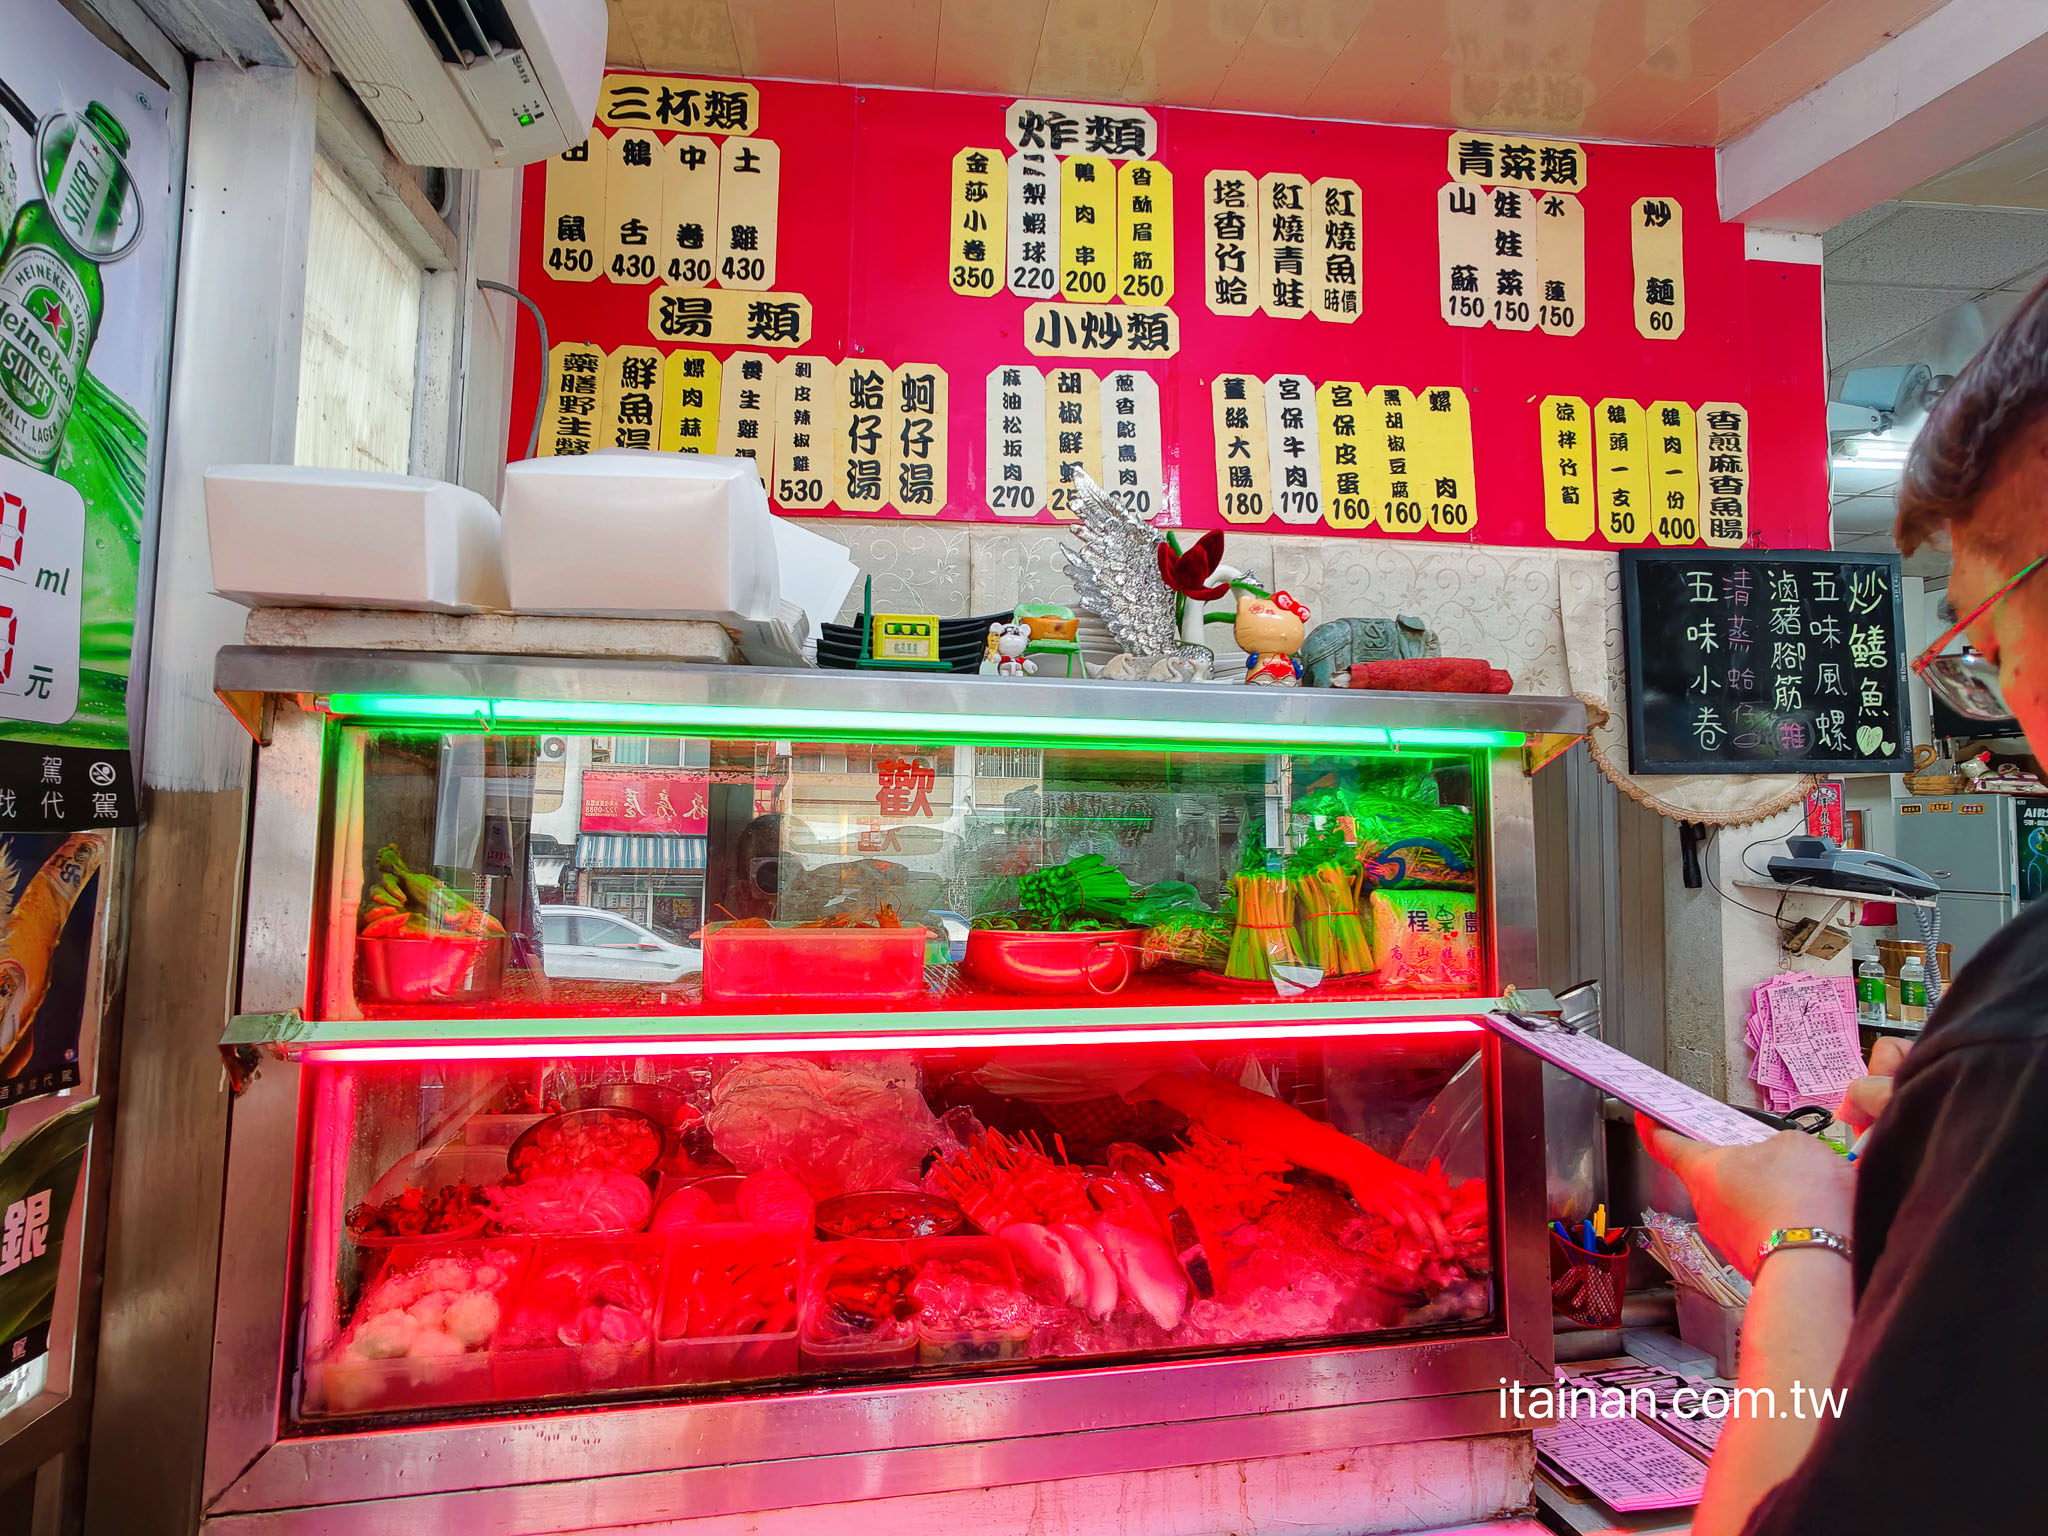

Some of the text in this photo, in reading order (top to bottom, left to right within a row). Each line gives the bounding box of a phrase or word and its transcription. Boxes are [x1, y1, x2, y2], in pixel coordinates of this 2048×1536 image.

[607, 86, 749, 130] 三杯類
[1018, 109, 1146, 157] 炸類
[1458, 140, 1578, 185] 青菜類
[62, 159, 99, 236] SILVER
[668, 145, 710, 281] 中卷 430
[721, 148, 765, 280] 土雞 430
[953, 152, 994, 289] 金莎小卷 350
[1066, 163, 1106, 293] 鴨肉串 200
[1213, 179, 1247, 305] 塔香竹蛤
[1272, 182, 1304, 308] 紅燒青蛙
[1324, 187, 1357, 314] 紅燒魚 時價
[1448, 187, 1485, 318] 山蘇 150
[15, 264, 74, 305] HEINEKEN
[73, 303, 84, 358] SILVER
[549, 248, 593, 272] 450
[611, 254, 655, 277] 430
[1013, 266, 1054, 289] 220
[1123, 275, 1163, 297] 250
[1494, 190, 1530, 322] 娃娃菜 150
[1539, 196, 1575, 328] 水蓮 150
[1643, 201, 1675, 331] 炒麵 60
[659, 296, 800, 342] 湯類
[1035, 310, 1170, 351] 小炒類
[2, 348, 50, 407] SILVER
[847, 369, 884, 500] 蛤仔湯
[899, 373, 936, 504] 蚵仔湯
[1223, 377, 1263, 516] 薑絲大腸 180
[1279, 378, 1318, 514] 宮保牛肉 170
[1331, 385, 1370, 520] 宮保皮蛋 160
[1383, 389, 1421, 524] 黑胡椒豆腐 160
[1430, 390, 1468, 525] 螺肉 160
[779, 479, 823, 502] 530
[992, 485, 1034, 508] 270
[1052, 488, 1080, 511] 25
[1610, 512, 1635, 534] 50
[1659, 517, 1695, 539] 400
[35, 567, 69, 596] ml
[24, 664, 53, 699] 元
[1686, 571, 1728, 751] 五味小卷
[1767, 570, 1806, 712] 滷豬腳筋
[1809, 571, 1851, 751] 五味風螺
[1848, 570, 1889, 717] 炒鱔魚
[41, 755, 62, 785] 駕
[876, 757, 935, 818] 歡
[0, 1188, 52, 1276] 銀
